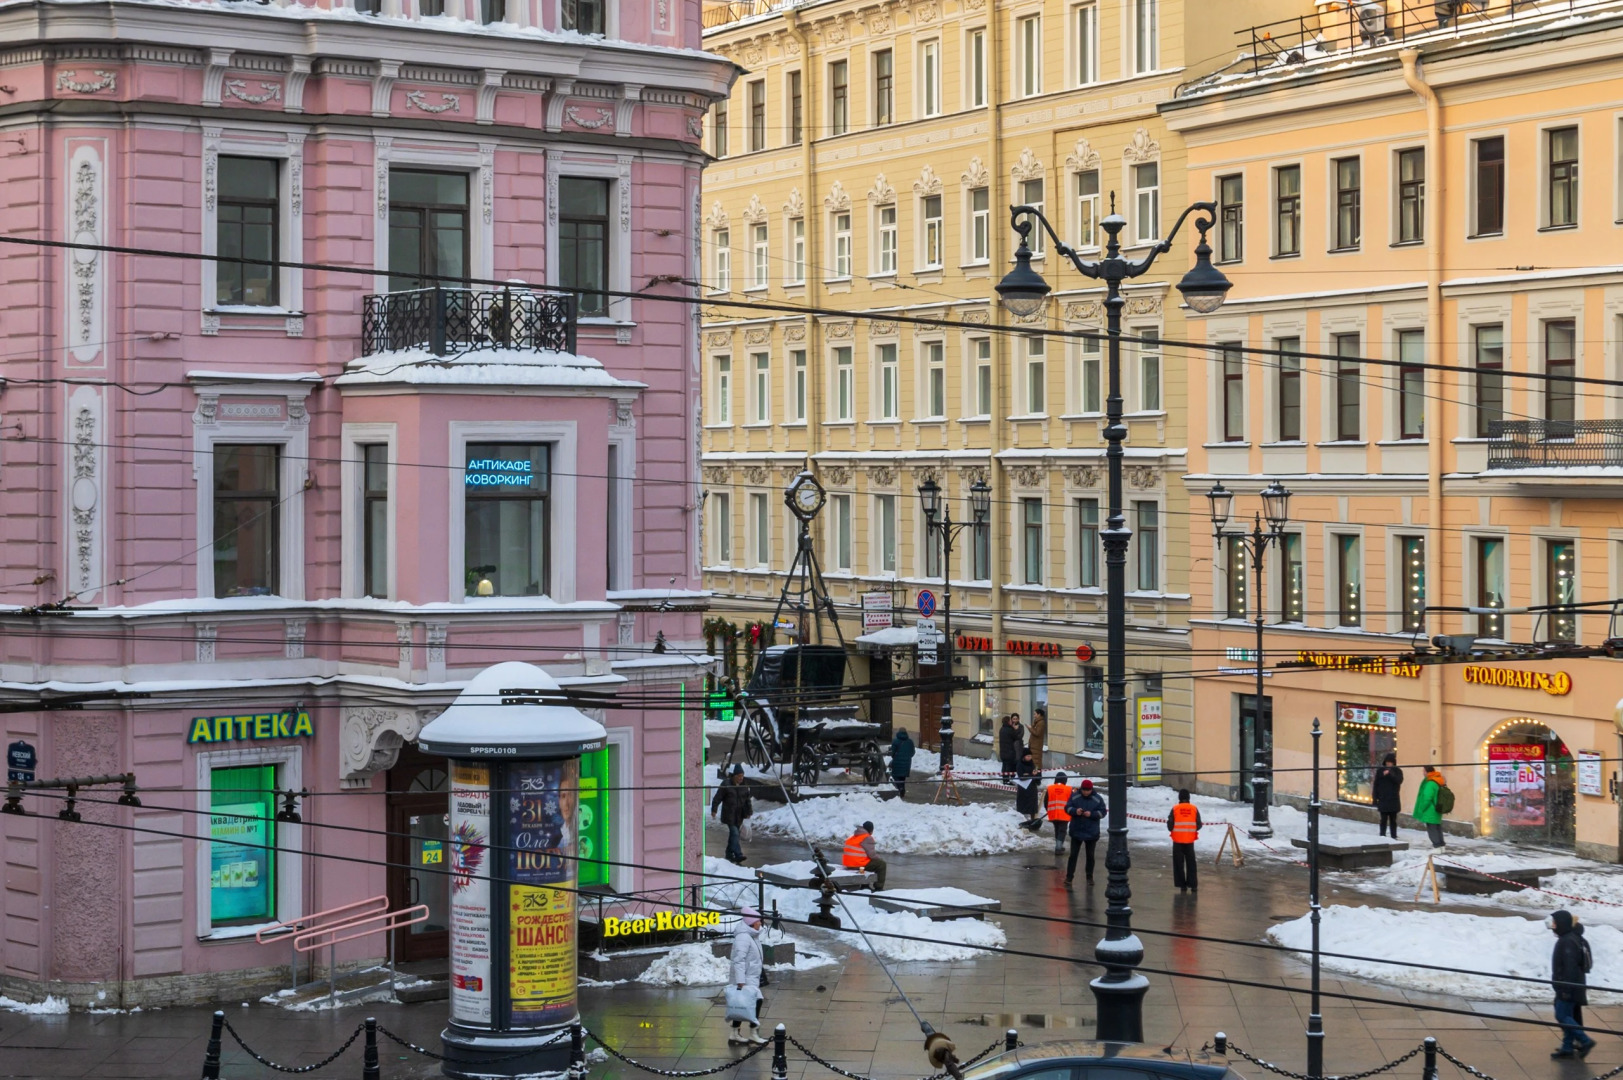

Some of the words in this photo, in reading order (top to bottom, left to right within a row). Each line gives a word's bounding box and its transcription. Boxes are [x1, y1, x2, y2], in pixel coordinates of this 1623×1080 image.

[468, 460, 531, 471] АНТИКАФЕ
[465, 474, 533, 485] КОВОРКИНГ
[1006, 640, 1061, 658] ОДЕЖДА
[1391, 658, 1421, 677] БАР
[1463, 665, 1532, 688] СТОЛОВАЯ
[190, 712, 314, 743] АПТЕКА
[522, 799, 542, 823] 31
[516, 832, 550, 849] Олег
[426, 853, 439, 863] 24
